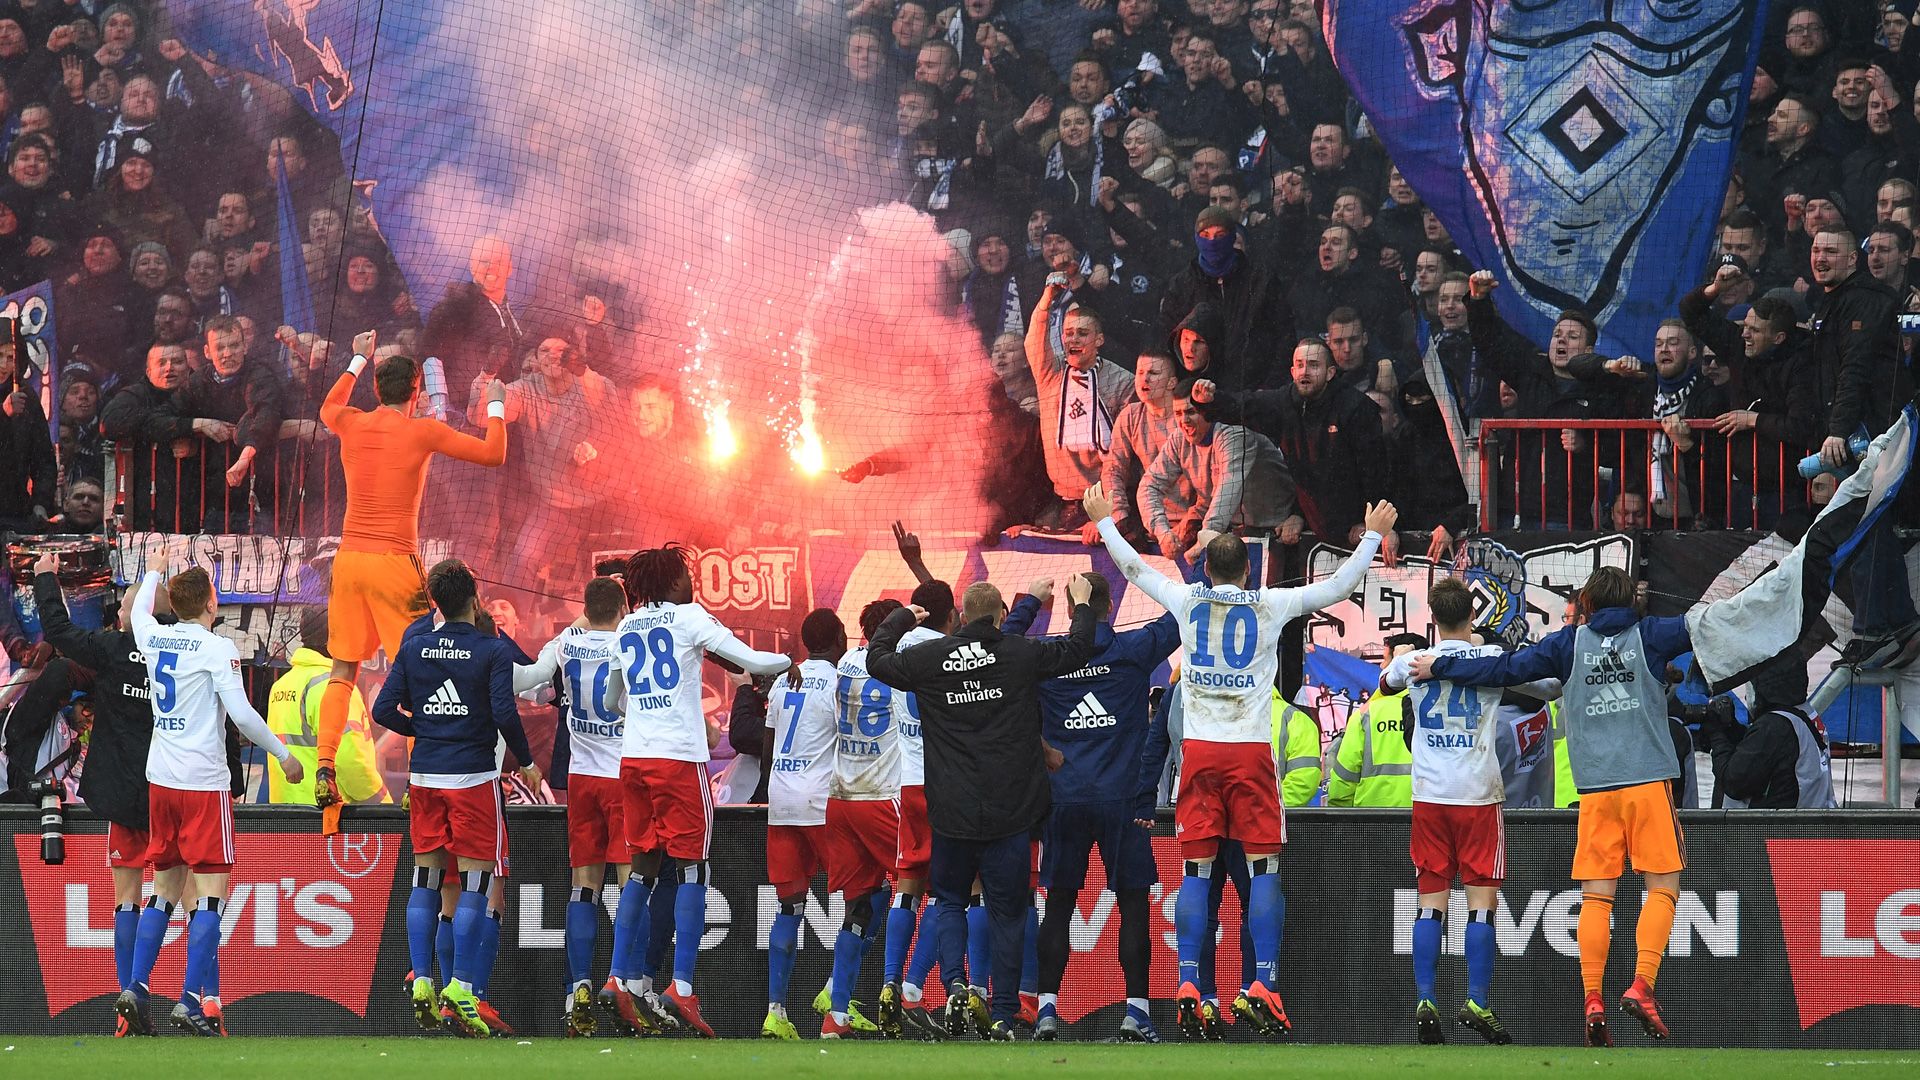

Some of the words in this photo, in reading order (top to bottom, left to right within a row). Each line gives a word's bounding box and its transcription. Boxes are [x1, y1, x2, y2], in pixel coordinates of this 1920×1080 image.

[118, 532, 305, 595] VORSTADT
[697, 548, 799, 610] OST
[662, 611, 676, 625] SV
[439, 637, 455, 648] Fly
[1189, 602, 1259, 670] 10
[189, 639, 203, 652] SV
[421, 647, 472, 660] Emirates
[619, 627, 681, 696] 28
[942, 652, 997, 672] adidas
[155, 650, 179, 714] 5
[963, 680, 982, 691] Fly
[1188, 669, 1257, 688] LASOGGA
[1585, 671, 1635, 686] adidas
[639, 694, 673, 711] JUNG
[946, 686, 1004, 705] Emirates
[423, 702, 469, 716] adidas
[837, 674, 892, 738] 18
[1413, 681, 1482, 730] 24
[1585, 698, 1640, 716] adidas
[781, 691, 807, 755] 7
[1064, 714, 1118, 730] adidas
[1427, 734, 1474, 749] SAKAI
[772, 758, 812, 772] AREY
